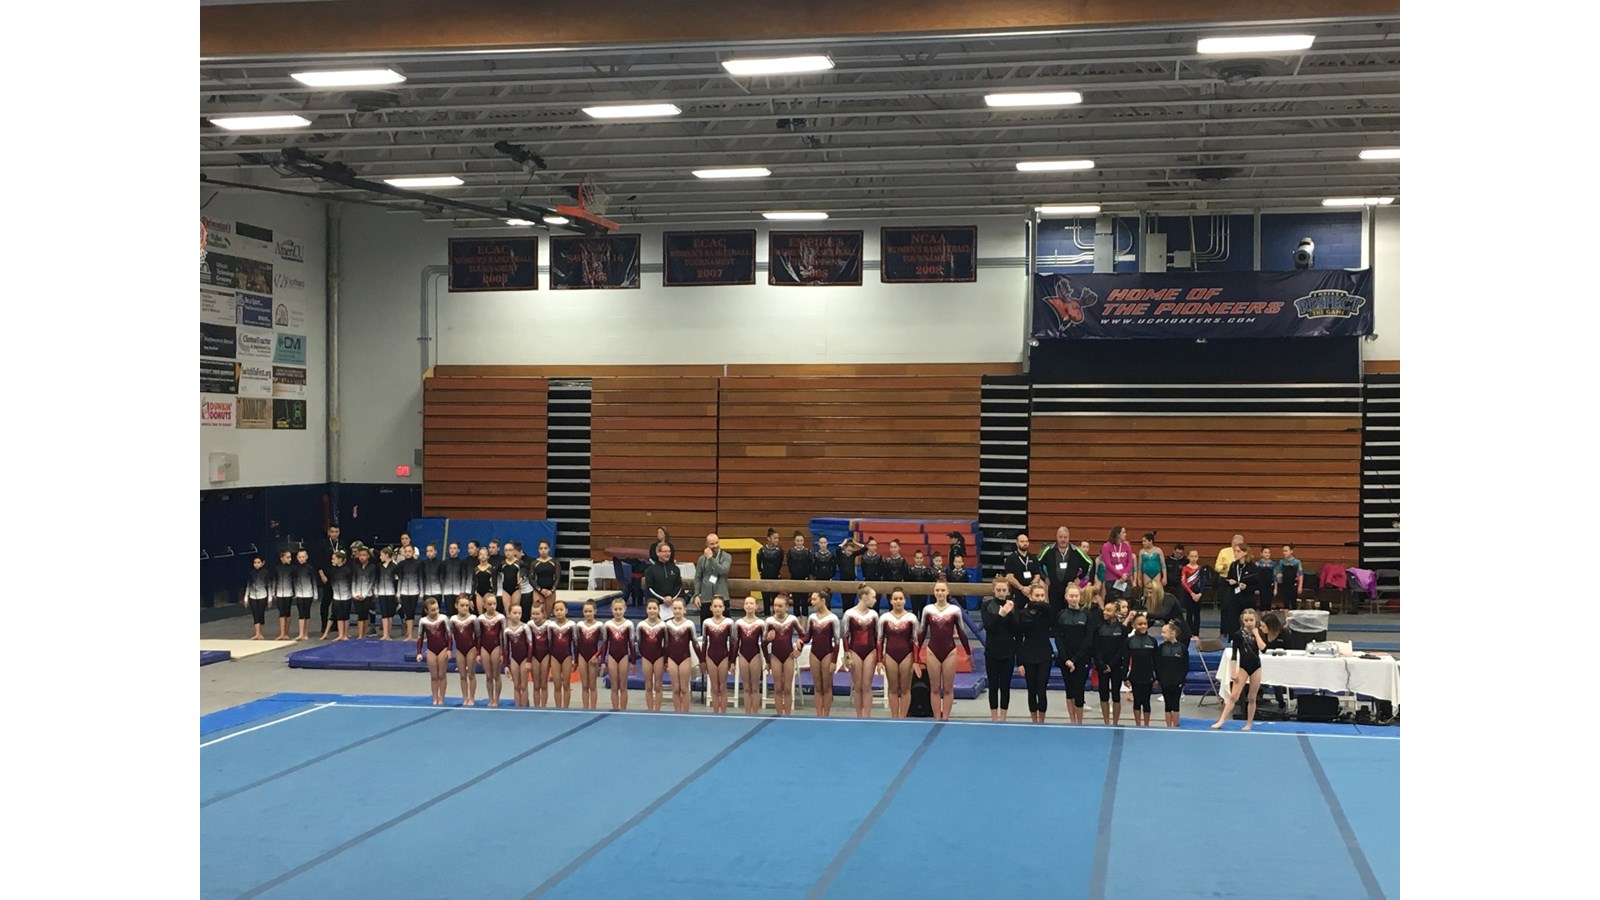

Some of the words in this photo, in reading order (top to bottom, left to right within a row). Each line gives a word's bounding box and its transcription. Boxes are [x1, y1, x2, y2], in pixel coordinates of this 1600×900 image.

[693, 238, 726, 248] ECAC
[911, 234, 946, 244] NCAA
[477, 245, 509, 254] ECAC
[670, 249, 704, 257] WOMEN'S
[705, 248, 752, 257] BASKETBALL
[684, 258, 736, 266] TOURNAMENT
[696, 269, 723, 278] 2007
[1106, 288, 1183, 301] HOME
[1185, 287, 1223, 301] OF
[1101, 303, 1151, 316] THE
[1153, 301, 1285, 315] PIONEERS
[1297, 296, 1363, 314] RESPECT
[1100, 317, 1256, 325] WWW.UCPIONEERS.COM
[210, 402, 232, 411] DUNKIN'
[209, 411, 232, 420] DONUTS
